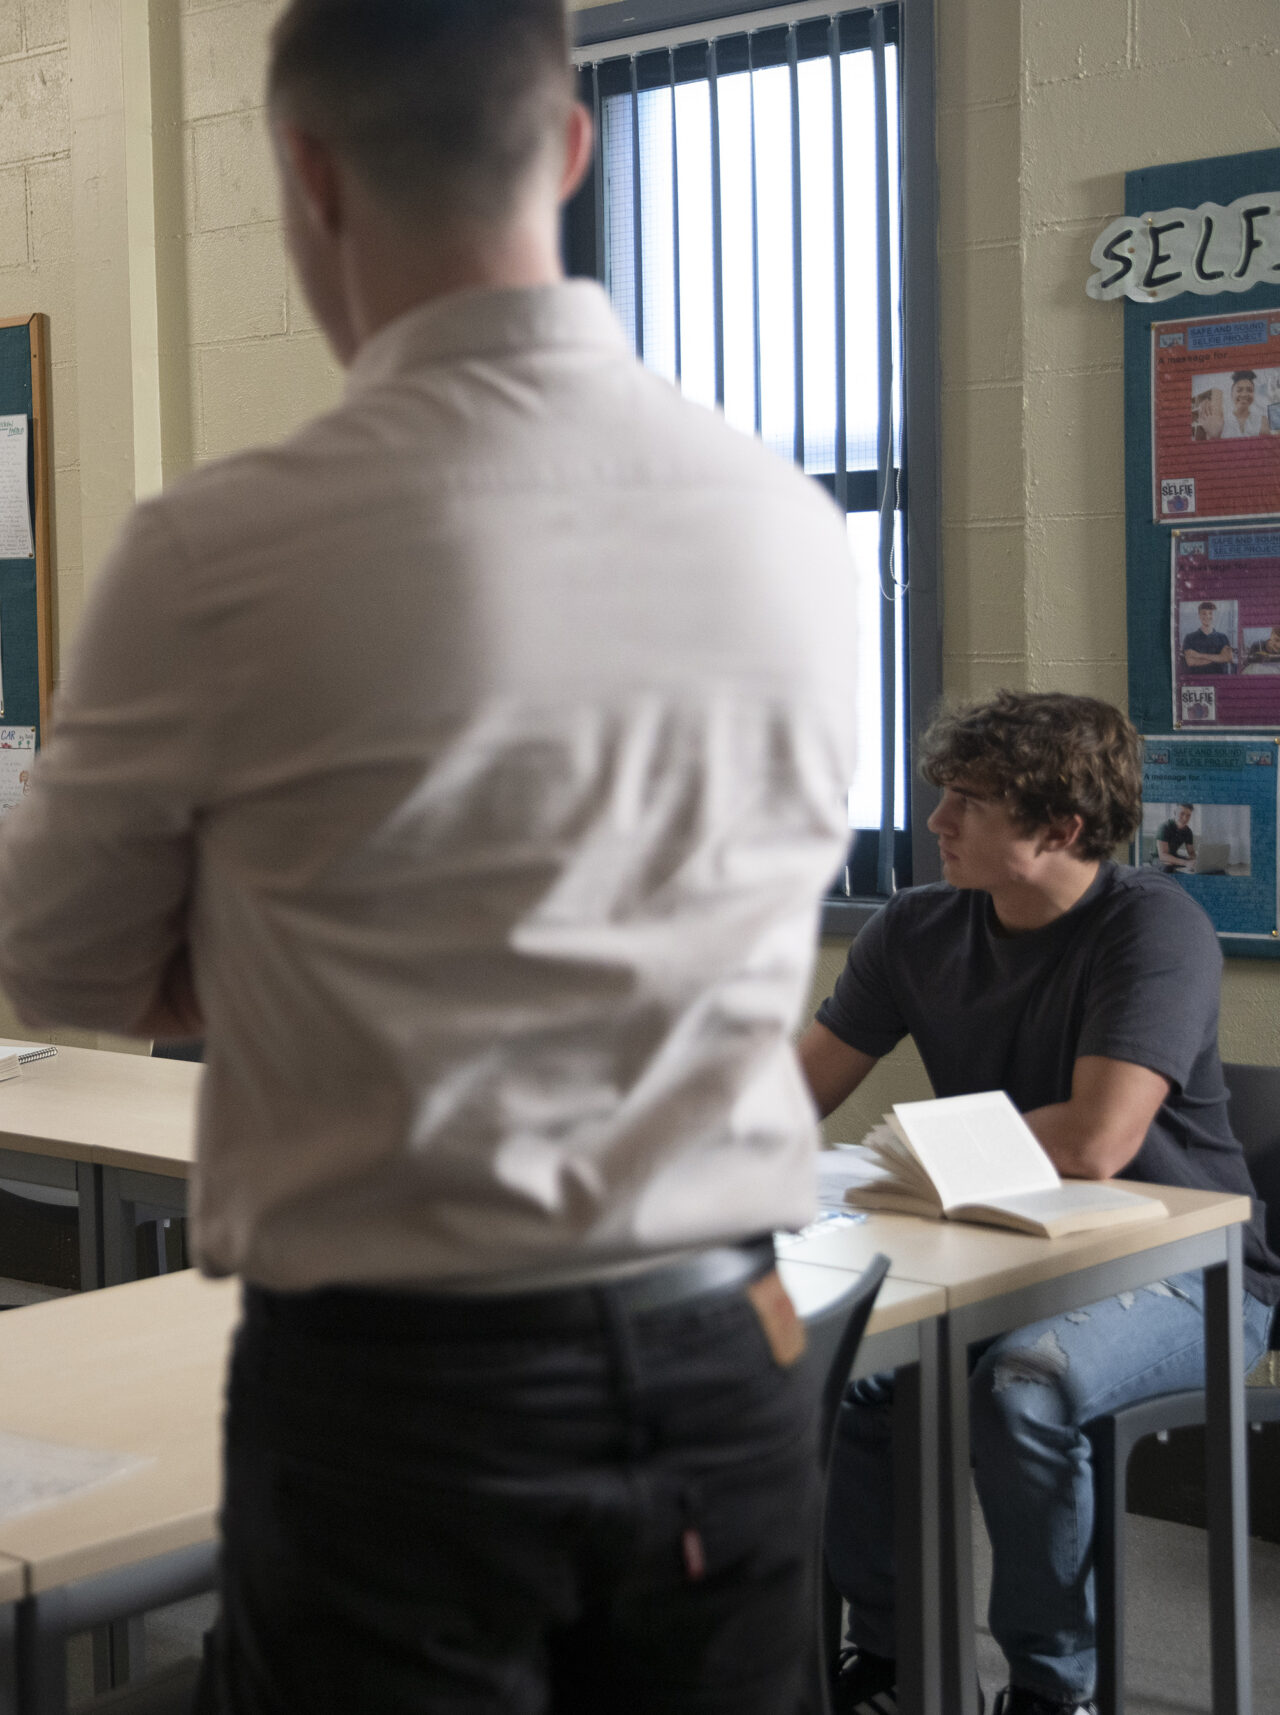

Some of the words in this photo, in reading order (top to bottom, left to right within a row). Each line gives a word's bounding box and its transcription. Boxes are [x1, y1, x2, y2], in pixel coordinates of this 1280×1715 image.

[1101, 206, 1280, 289] SELF
[1214, 351, 1228, 360] for
[1161, 484, 1195, 498] SELFIE
[1181, 690, 1214, 705] SELFIE
[0, 729, 16, 741] CAR
